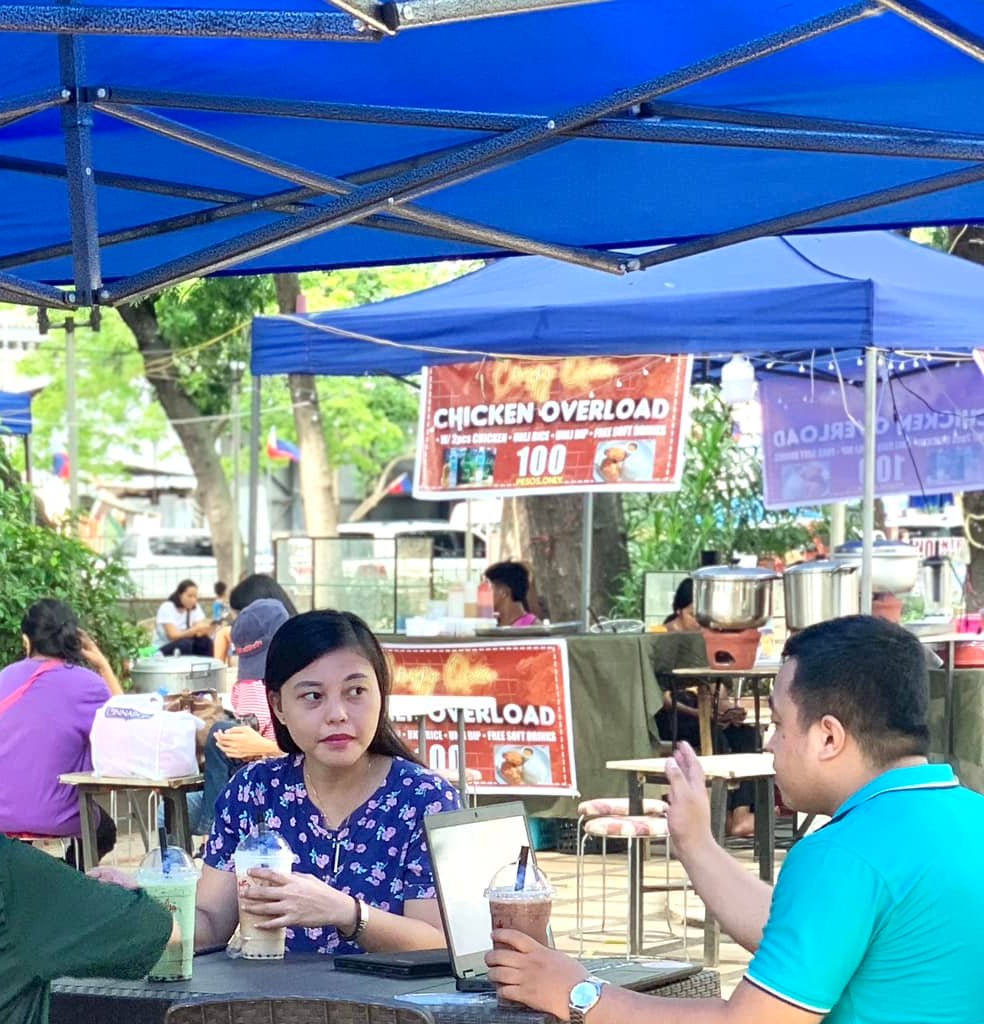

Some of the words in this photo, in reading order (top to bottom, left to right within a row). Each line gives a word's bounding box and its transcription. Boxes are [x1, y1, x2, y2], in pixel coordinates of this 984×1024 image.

[434, 402, 534, 430] CHICKEN
[539, 398, 670, 423] OVERLOAD
[516, 444, 567, 477] 100
